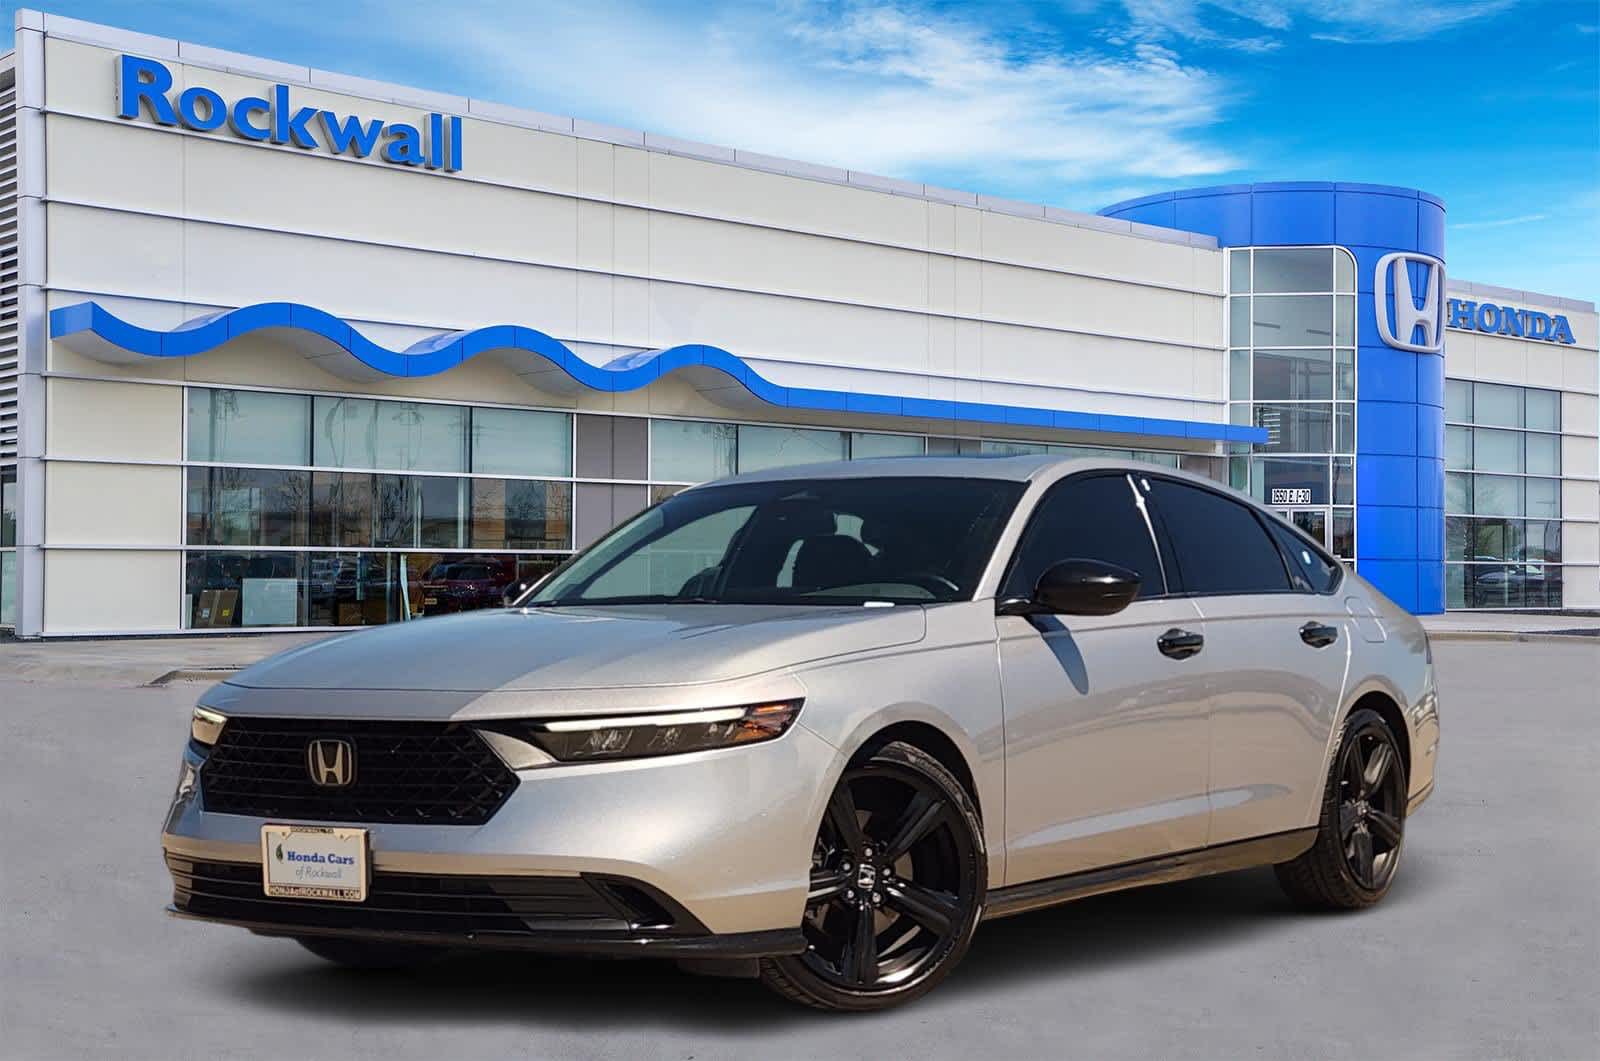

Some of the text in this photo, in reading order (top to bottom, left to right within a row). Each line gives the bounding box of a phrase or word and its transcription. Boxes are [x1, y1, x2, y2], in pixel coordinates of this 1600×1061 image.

[116, 53, 463, 173] Rockwall
[1446, 298, 1576, 344] HONDA
[1273, 489, 1288, 503] 1550
[1296, 489, 1310, 503] I-30
[287, 851, 354, 865] Honda Cars
[296, 865, 342, 880] of Rockwall
